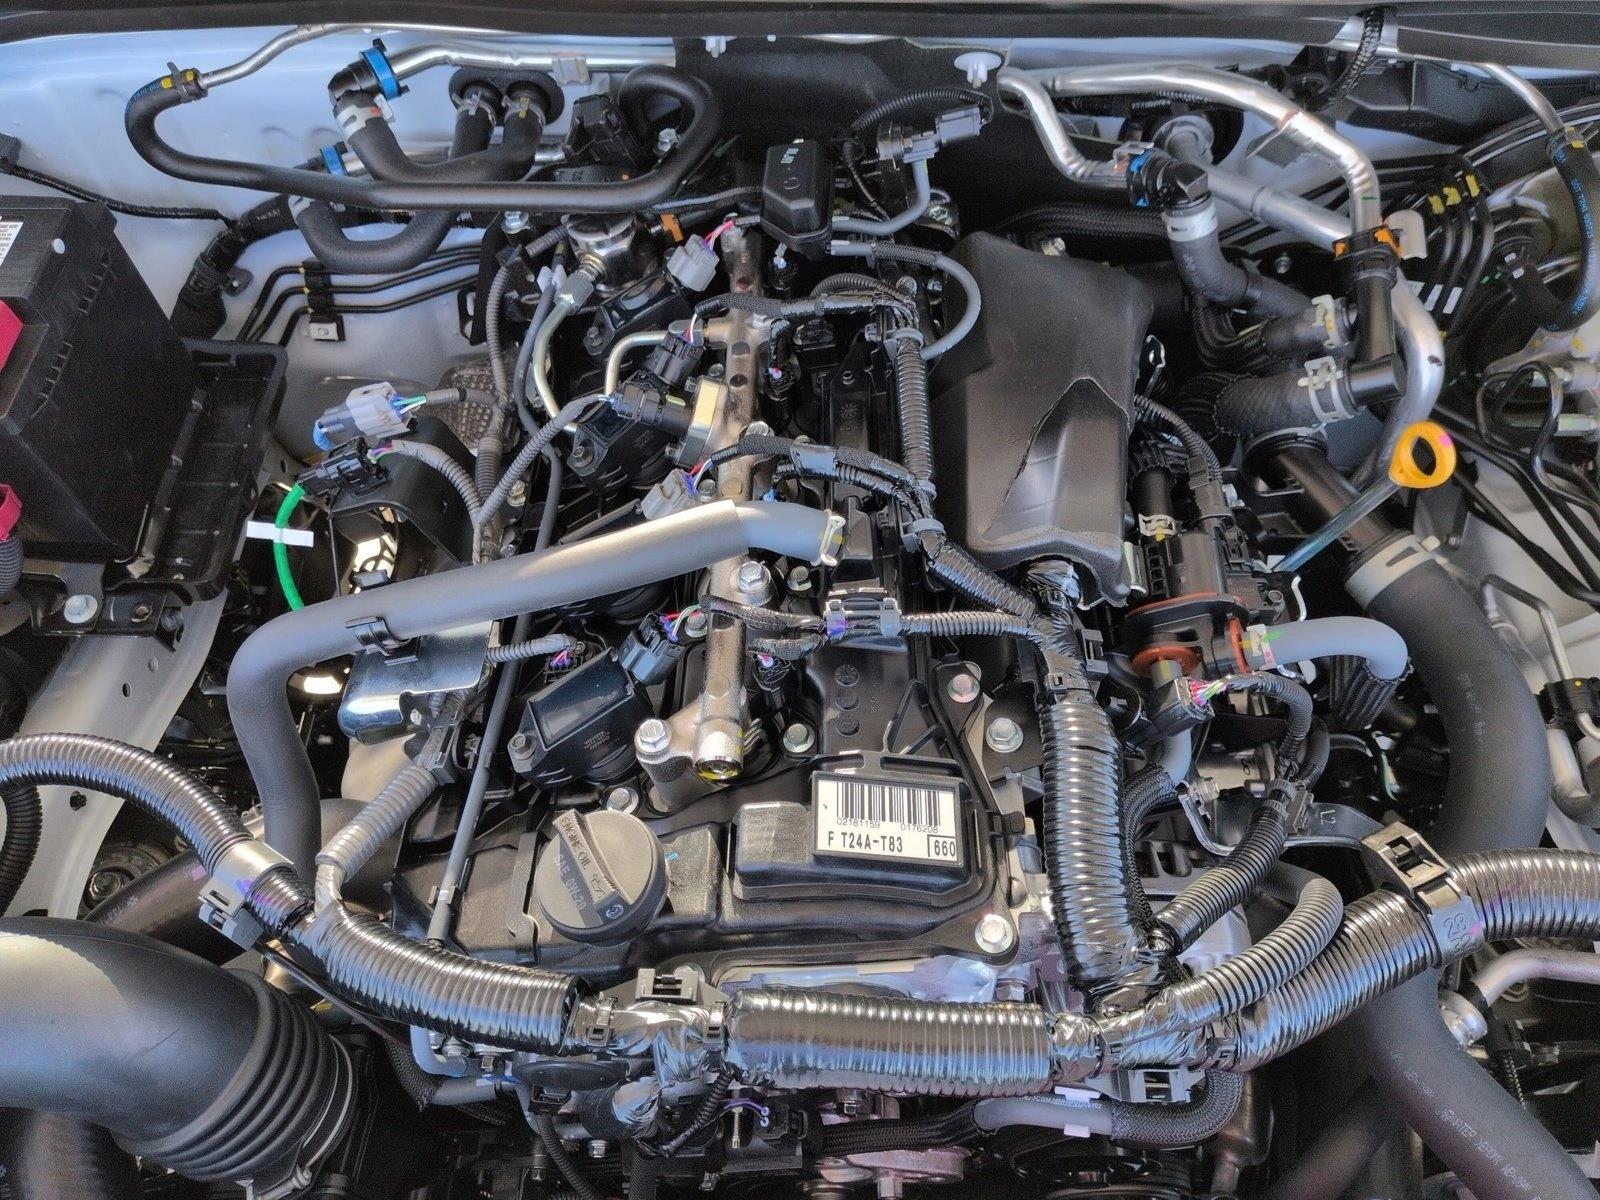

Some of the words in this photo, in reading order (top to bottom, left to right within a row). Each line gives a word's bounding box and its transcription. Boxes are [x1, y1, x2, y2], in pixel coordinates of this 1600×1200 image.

[836, 817, 881, 829] 02181159
[560, 817, 584, 852] ENGINE
[578, 851, 592, 871] OIL
[828, 830, 835, 847] F
[841, 831, 903, 853] T24A-T83
[934, 839, 956, 858] 660
[554, 855, 571, 876] SAE
[565, 878, 587, 911] 0W-20
[1443, 912, 1467, 940] 28
